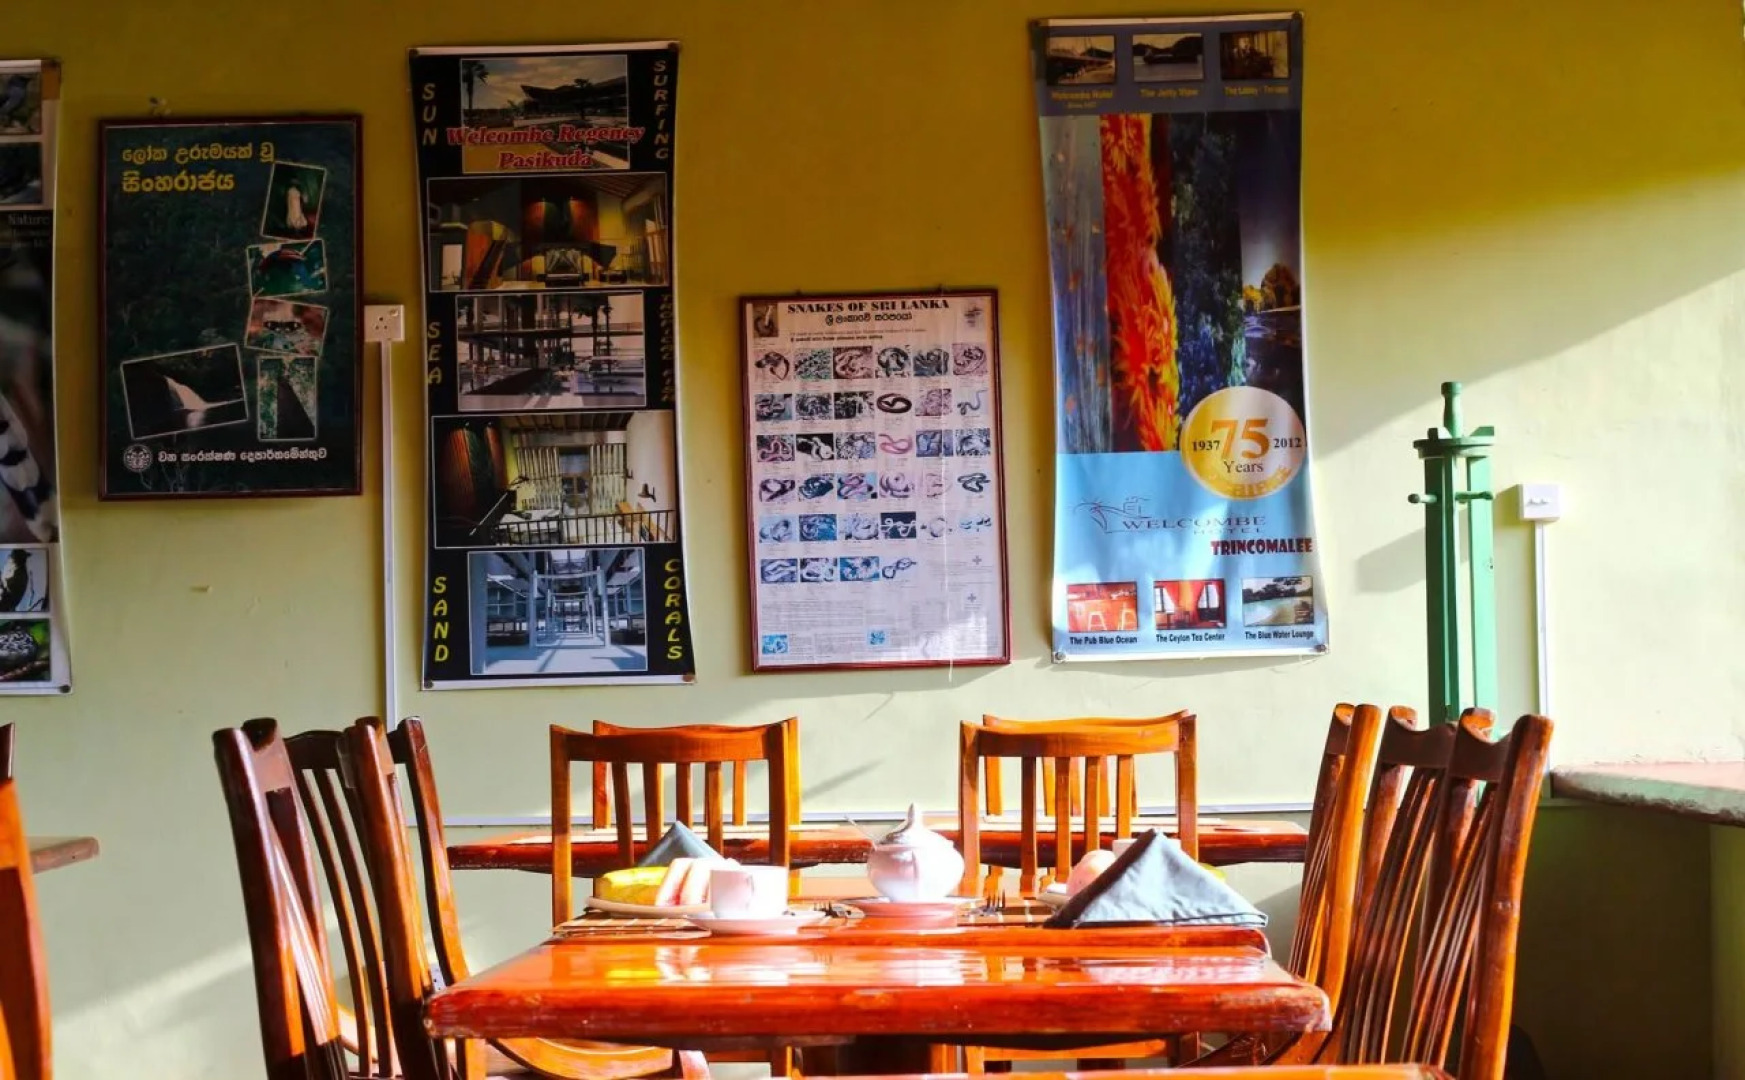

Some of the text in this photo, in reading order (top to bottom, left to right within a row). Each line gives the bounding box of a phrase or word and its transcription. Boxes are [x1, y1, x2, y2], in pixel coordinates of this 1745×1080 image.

[422, 83, 437, 146] SUN
[652, 59, 669, 159] SURFING
[446, 124, 646, 146] Welcombe Regency
[122, 145, 167, 165] ලෝක
[499, 150, 592, 170] Pasikuda
[122, 169, 235, 193] සිංහරාජය
[787, 299, 950, 314] SNAKES OF SRI LANKA
[427, 321, 443, 384] SEA
[1192, 418, 1301, 460] 1937 75 2012
[1223, 460, 1264, 474] Years
[1122, 516, 1266, 530] WELCOMBE
[1210, 537, 1313, 556] TRINCOMALEE
[433, 576, 449, 662] SAND
[664, 559, 683, 660] CORALS
[1069, 635, 1138, 645] The Pub Blue Ocean
[1156, 634, 1169, 643] The
[1204, 632, 1225, 642] Center
[1244, 631, 1257, 640] The
